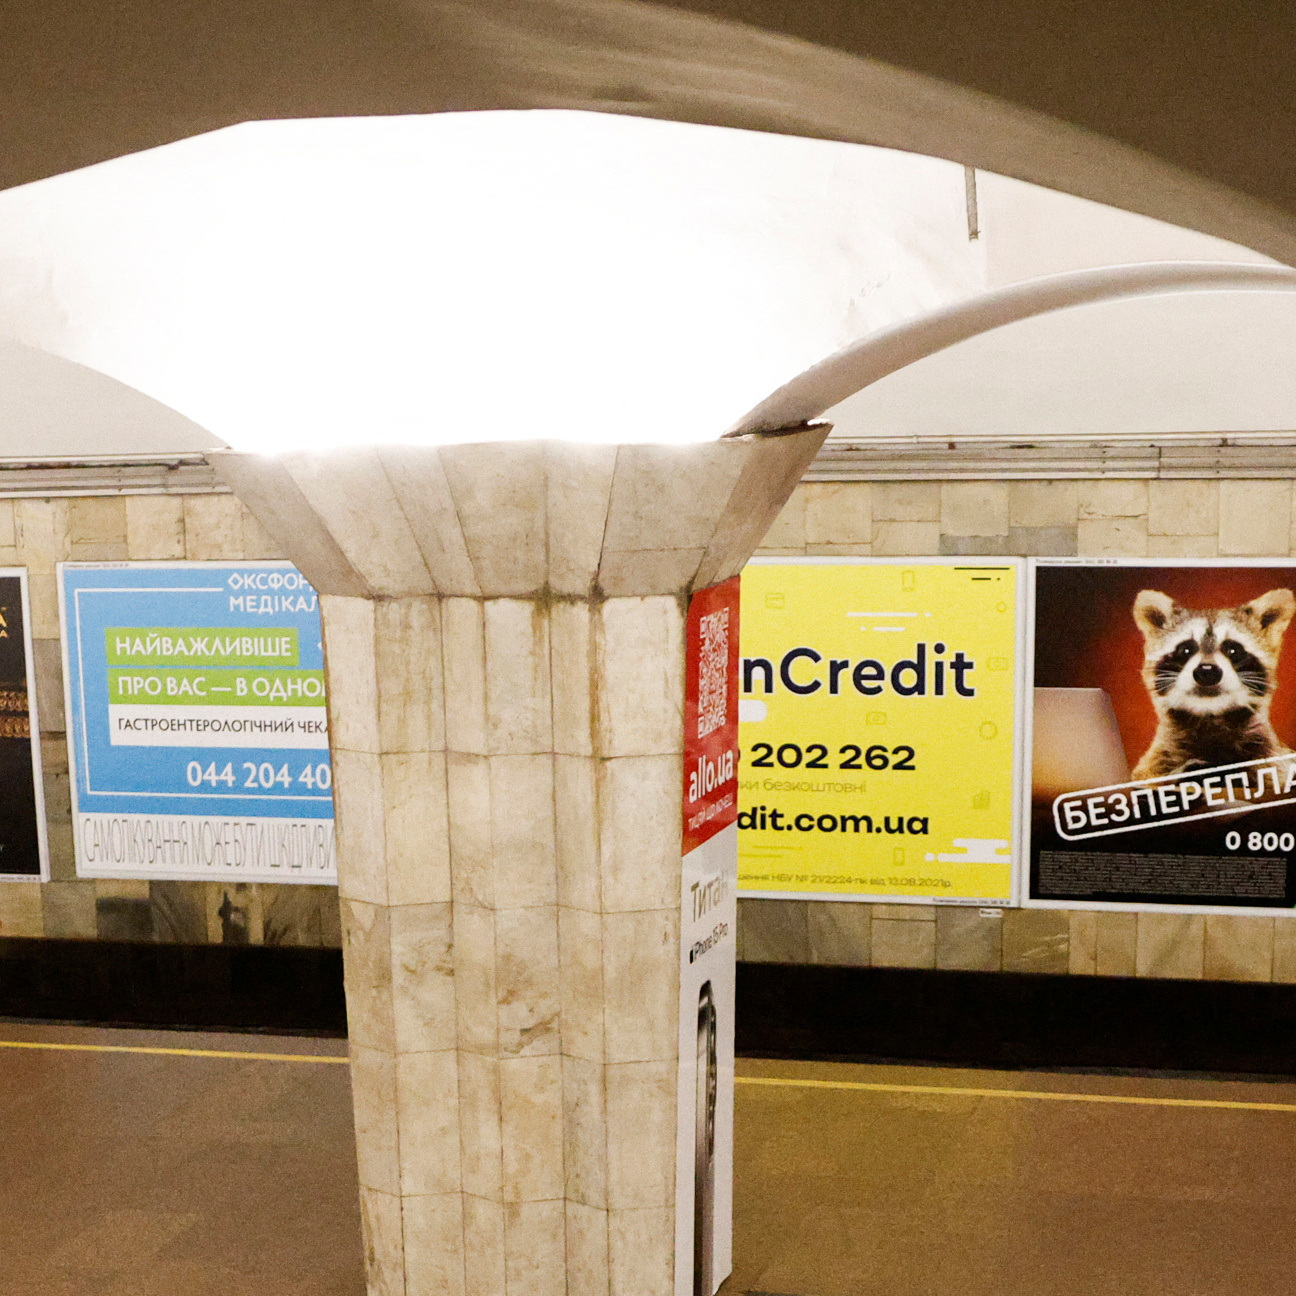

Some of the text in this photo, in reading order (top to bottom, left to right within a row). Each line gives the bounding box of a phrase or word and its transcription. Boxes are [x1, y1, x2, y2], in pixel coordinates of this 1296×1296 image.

[227, 571, 315, 592] ОКСФОР
[115, 633, 292, 657] НАЙВАЖЛИВІШЕ
[742, 642, 975, 698] nCredit
[117, 676, 162, 696] ПРО
[166, 677, 207, 696] ВАС
[236, 678, 248, 697] В
[252, 677, 326, 702] ОДНО
[117, 717, 295, 734] ГАСТРОЕНТЕРОЛОГІЧНИЙ
[751, 743, 829, 769] 202
[839, 745, 916, 771] 262
[186, 760, 332, 790] 044 204 40
[688, 749, 734, 803] allo.ua
[763, 777, 867, 793] безкоштовні
[737, 805, 930, 836] dit.com.ua
[85, 818, 190, 866] САМОЛІКУВАННЯ
[190, 821, 232, 867] МОЖЕ
[233, 822, 265, 868] БУТИ
[1225, 831, 1241, 850] 0
[1247, 832, 1296, 852] 800
